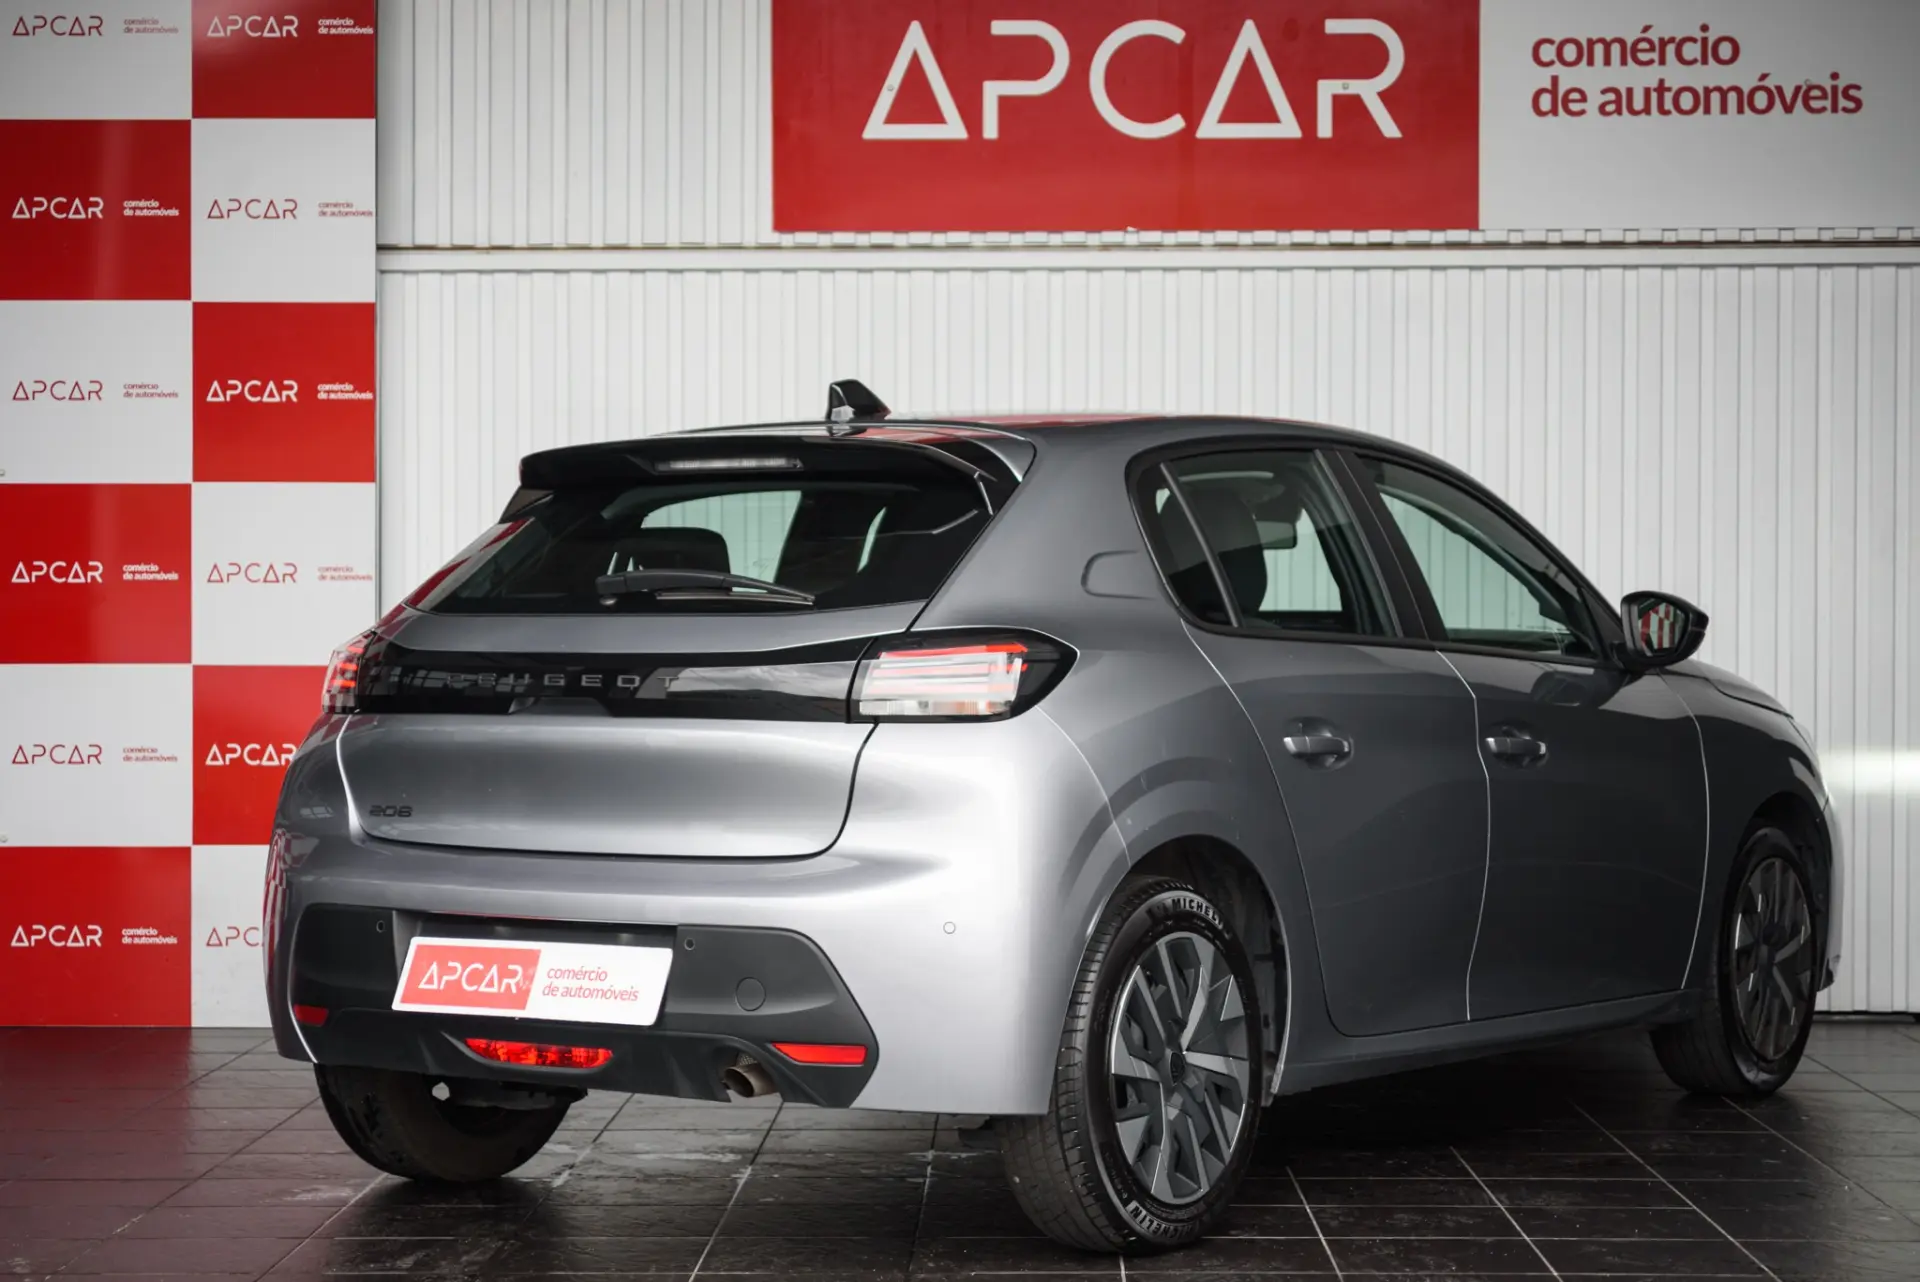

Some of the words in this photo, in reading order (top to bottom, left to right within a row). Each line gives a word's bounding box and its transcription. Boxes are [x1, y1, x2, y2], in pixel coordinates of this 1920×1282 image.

[12, 15, 104, 37] APCAR
[123, 17, 158, 26] comércio
[206, 15, 299, 37] APCAR
[318, 17, 353, 26] comércio
[123, 26, 134, 34] de
[135, 26, 178, 34] automóveis
[318, 26, 329, 34] de
[330, 26, 373, 34] automóveis
[1531, 23, 1741, 68] comércio
[862, 18, 1404, 140] APCAR
[1531, 75, 1588, 117] de
[1597, 72, 1863, 117] automóveis
[12, 197, 104, 219] APCAR
[123, 199, 158, 208] comércio
[318, 201, 353, 209] comércio
[123, 208, 134, 217] de
[135, 208, 178, 217] automóveis
[207, 198, 298, 219] APCAR
[318, 209, 329, 218] de
[330, 209, 373, 218] automóveis
[12, 380, 103, 401] APCAR
[123, 382, 158, 391] comércio
[206, 380, 298, 402] APCAR
[317, 382, 352, 391] comércio
[123, 391, 134, 399] de
[135, 391, 178, 399] automóveis
[317, 391, 328, 400] de
[329, 391, 372, 400] automóveis
[11, 561, 103, 583] APCAR
[123, 563, 158, 572] comércio
[318, 565, 353, 574] comércio
[123, 572, 134, 580] de
[135, 572, 178, 580] automóveis
[206, 562, 298, 583] APCAR
[318, 574, 329, 582] de
[330, 574, 373, 582] automóveis
[12, 744, 102, 765] APCAR
[123, 746, 158, 755] comércio
[123, 755, 134, 763] de
[135, 755, 178, 763] automóveis
[11, 925, 102, 947] APCAR
[122, 927, 157, 936] comércio
[122, 936, 133, 945] de
[134, 936, 177, 945] automóveis
[206, 926, 263, 947] APC
[418, 961, 524, 994] APCAR
[546, 966, 608, 983] comércio
[542, 981, 560, 997] de
[560, 983, 639, 1002] automóveis
